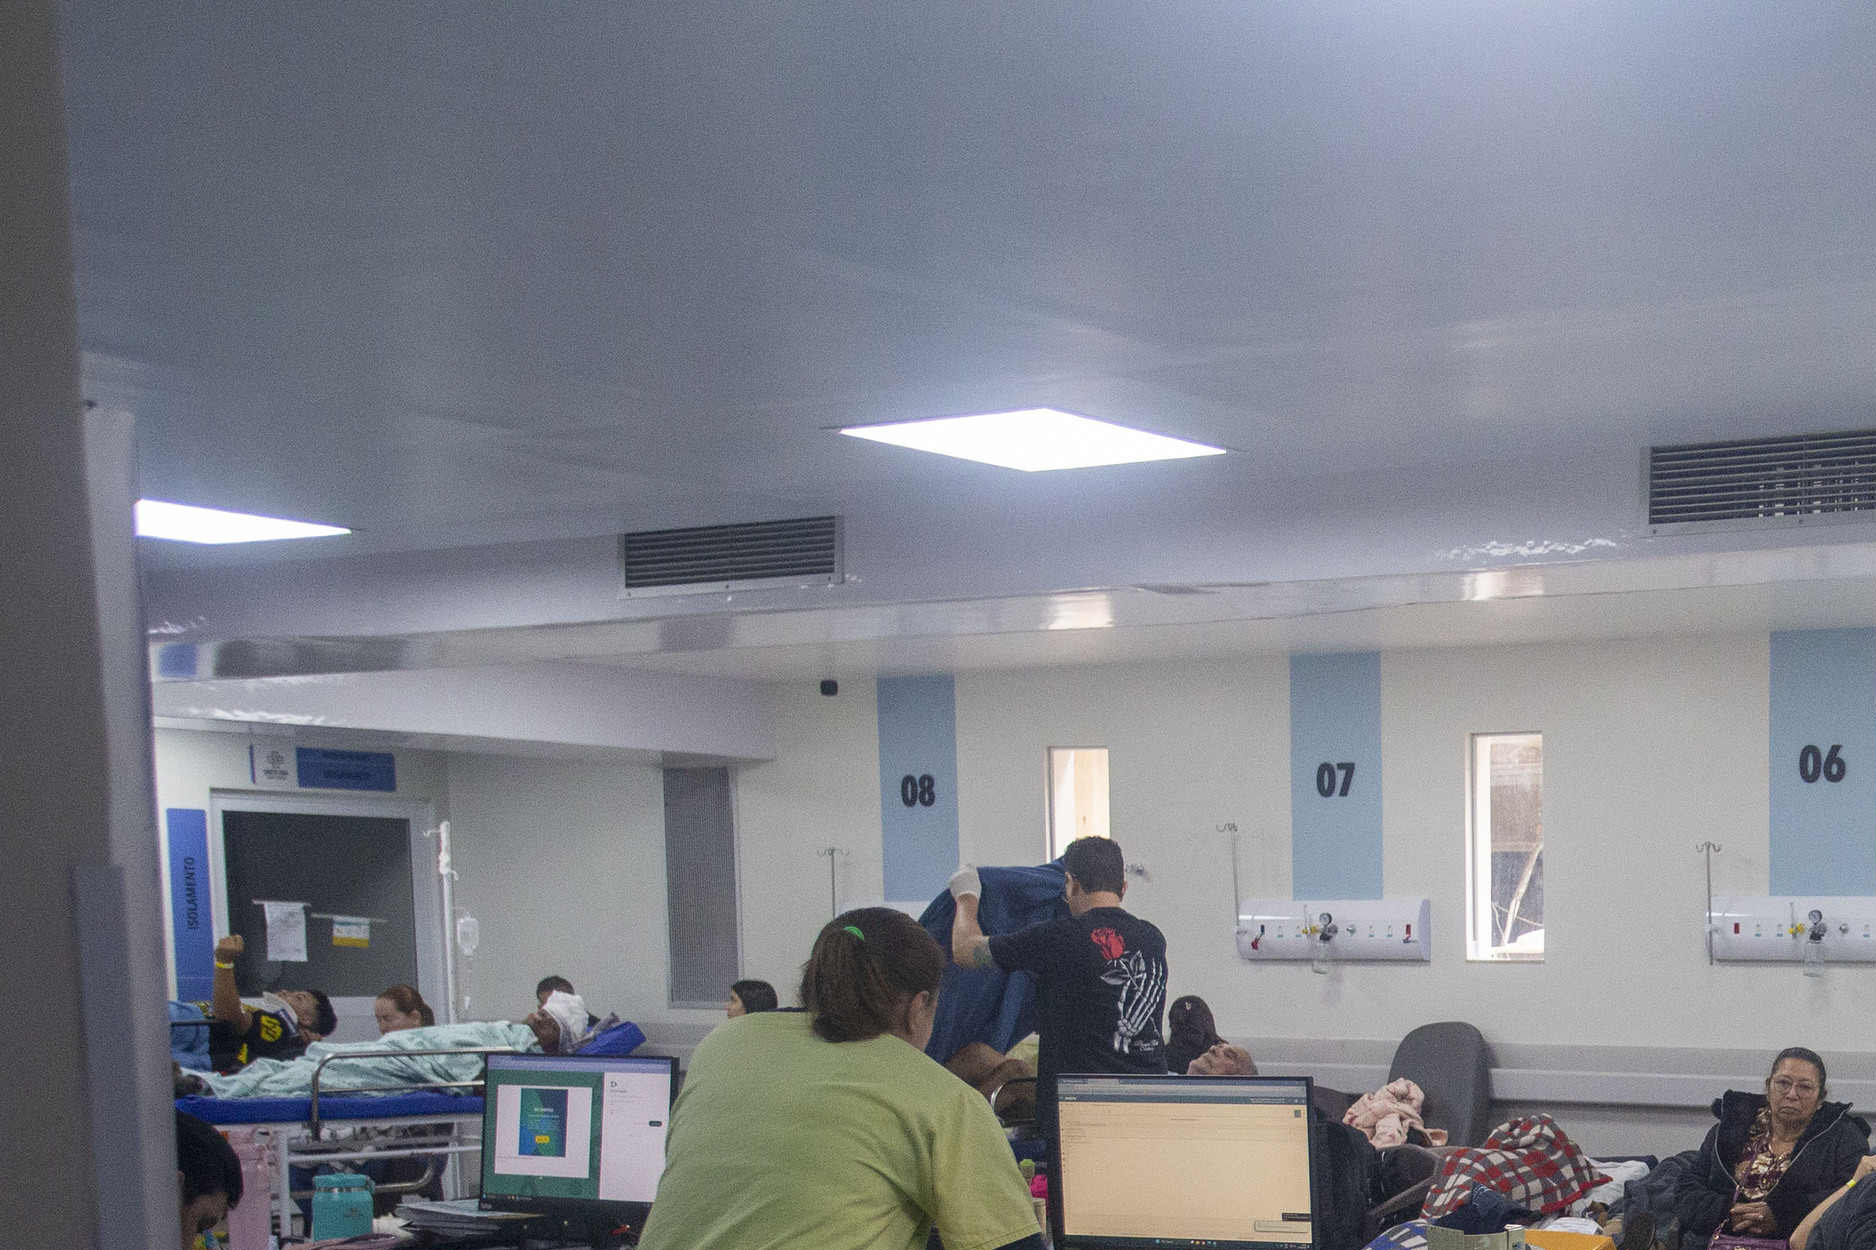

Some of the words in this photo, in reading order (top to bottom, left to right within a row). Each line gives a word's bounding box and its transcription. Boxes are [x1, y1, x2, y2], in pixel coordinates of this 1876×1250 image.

[1315, 761, 1356, 798] 07
[1798, 744, 1847, 784] 06
[900, 773, 936, 808] 08
[183, 856, 200, 931] ISOLAMENTO
